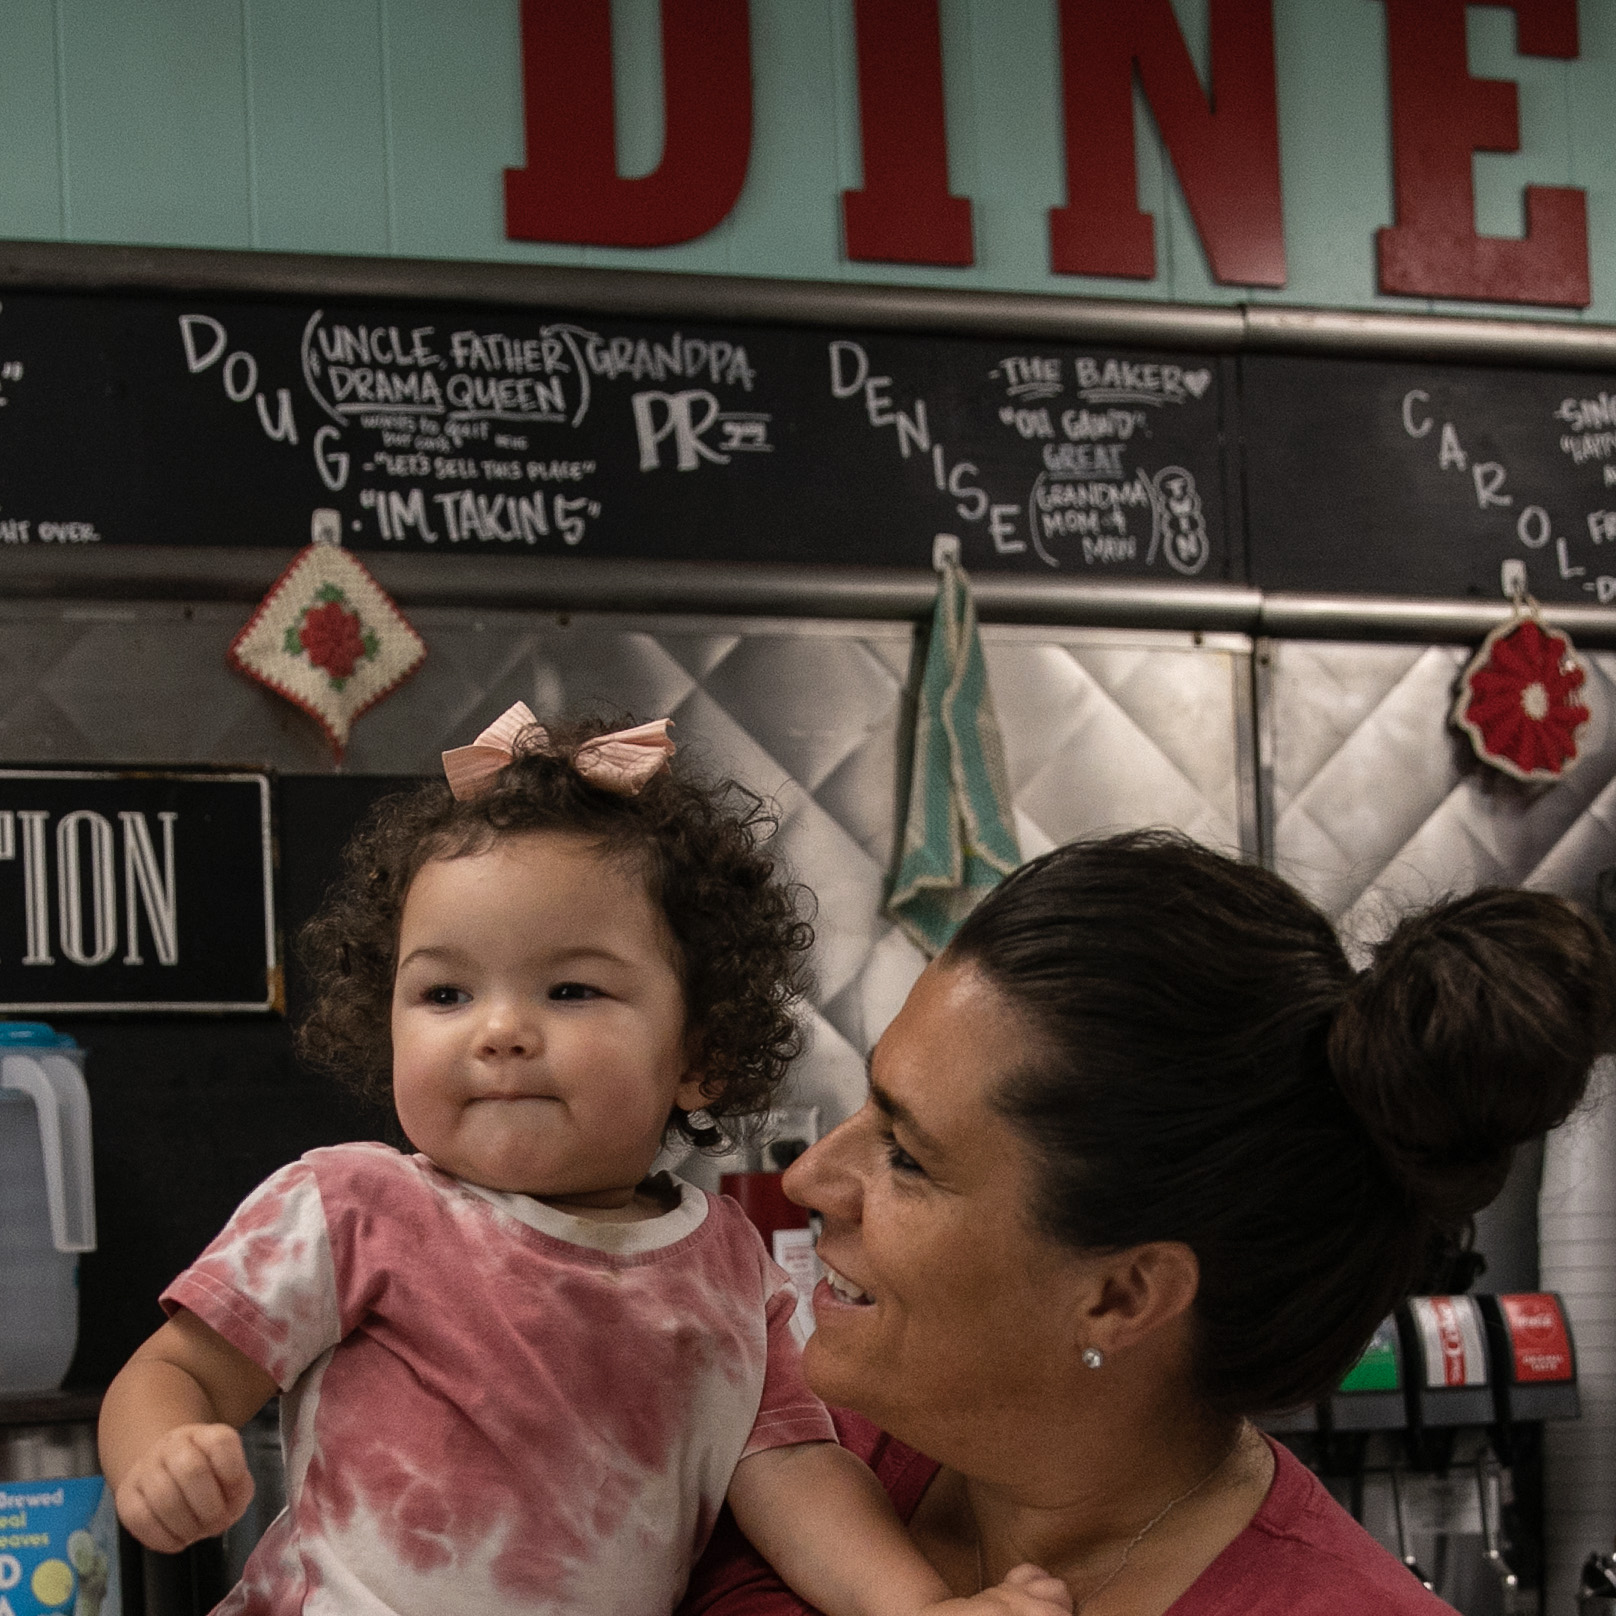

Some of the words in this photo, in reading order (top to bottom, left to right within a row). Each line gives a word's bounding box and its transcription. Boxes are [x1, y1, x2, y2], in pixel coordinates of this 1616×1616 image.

[328, 366, 444, 404] DRAMA
[445, 374, 568, 414] QUEEN
[1074, 356, 1185, 392] BAKER
[37, 520, 102, 544] OVER
